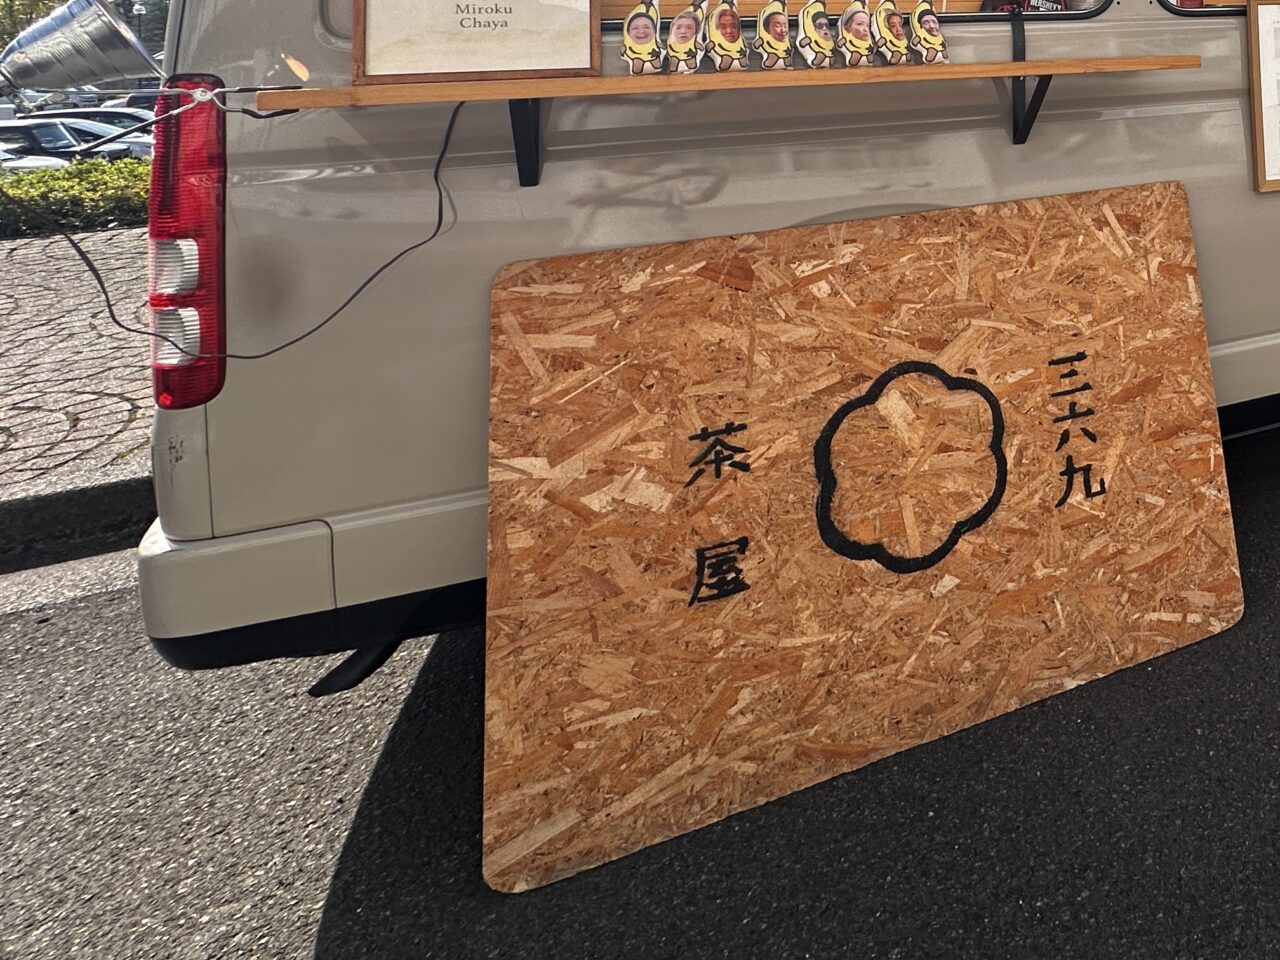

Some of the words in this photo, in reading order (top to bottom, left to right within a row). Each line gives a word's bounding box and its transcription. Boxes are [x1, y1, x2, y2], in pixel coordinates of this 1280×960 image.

[455, 3, 513, 15] Miroku
[460, 17, 508, 31] Chaya
[1048, 350, 1106, 509] 三六九
[684, 421, 751, 608] 茶屋
